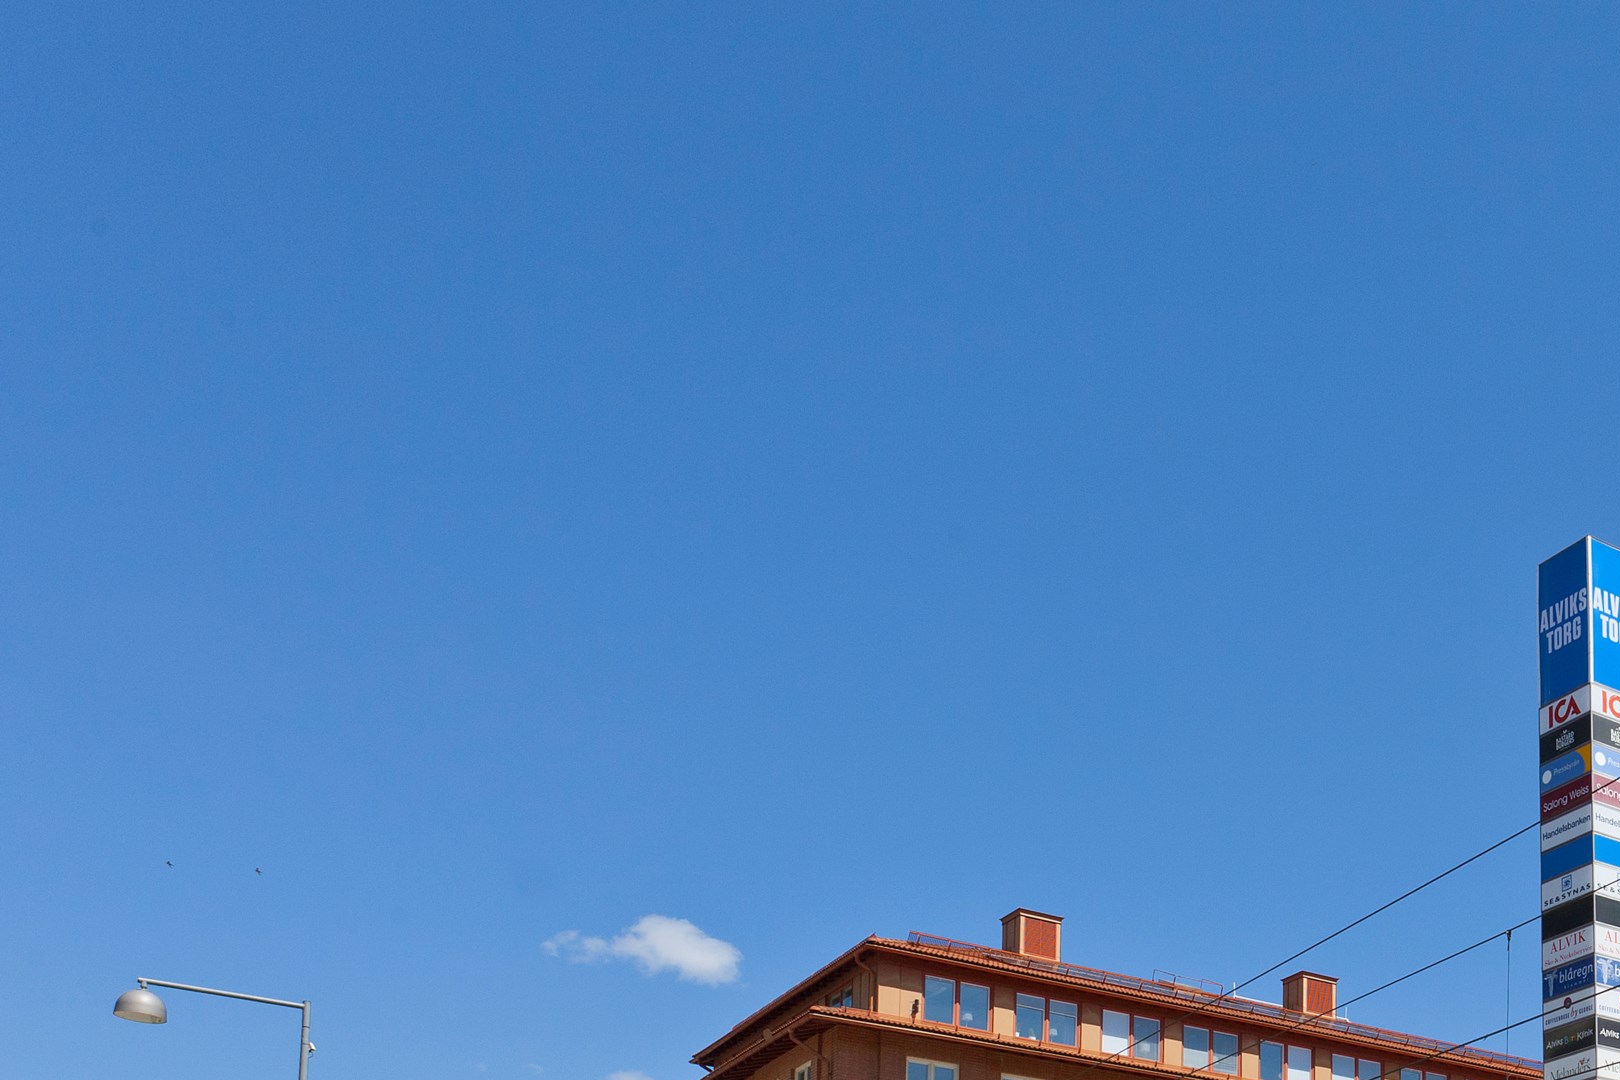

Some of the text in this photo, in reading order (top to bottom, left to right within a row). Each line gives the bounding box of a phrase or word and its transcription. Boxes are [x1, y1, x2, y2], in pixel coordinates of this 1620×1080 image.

[1540, 587, 1587, 633] ALVIKS
[1546, 615, 1581, 654] TORG
[1548, 695, 1581, 729] ICA
[1543, 785, 1590, 812] Salong Weiss
[1542, 814, 1591, 840] Handelsbanken
[1550, 930, 1586, 954] ALVIK
[1559, 963, 1593, 983] blåregn
[1570, 1007, 1578, 1019] by
[1550, 1062, 1591, 1080] Melanders
